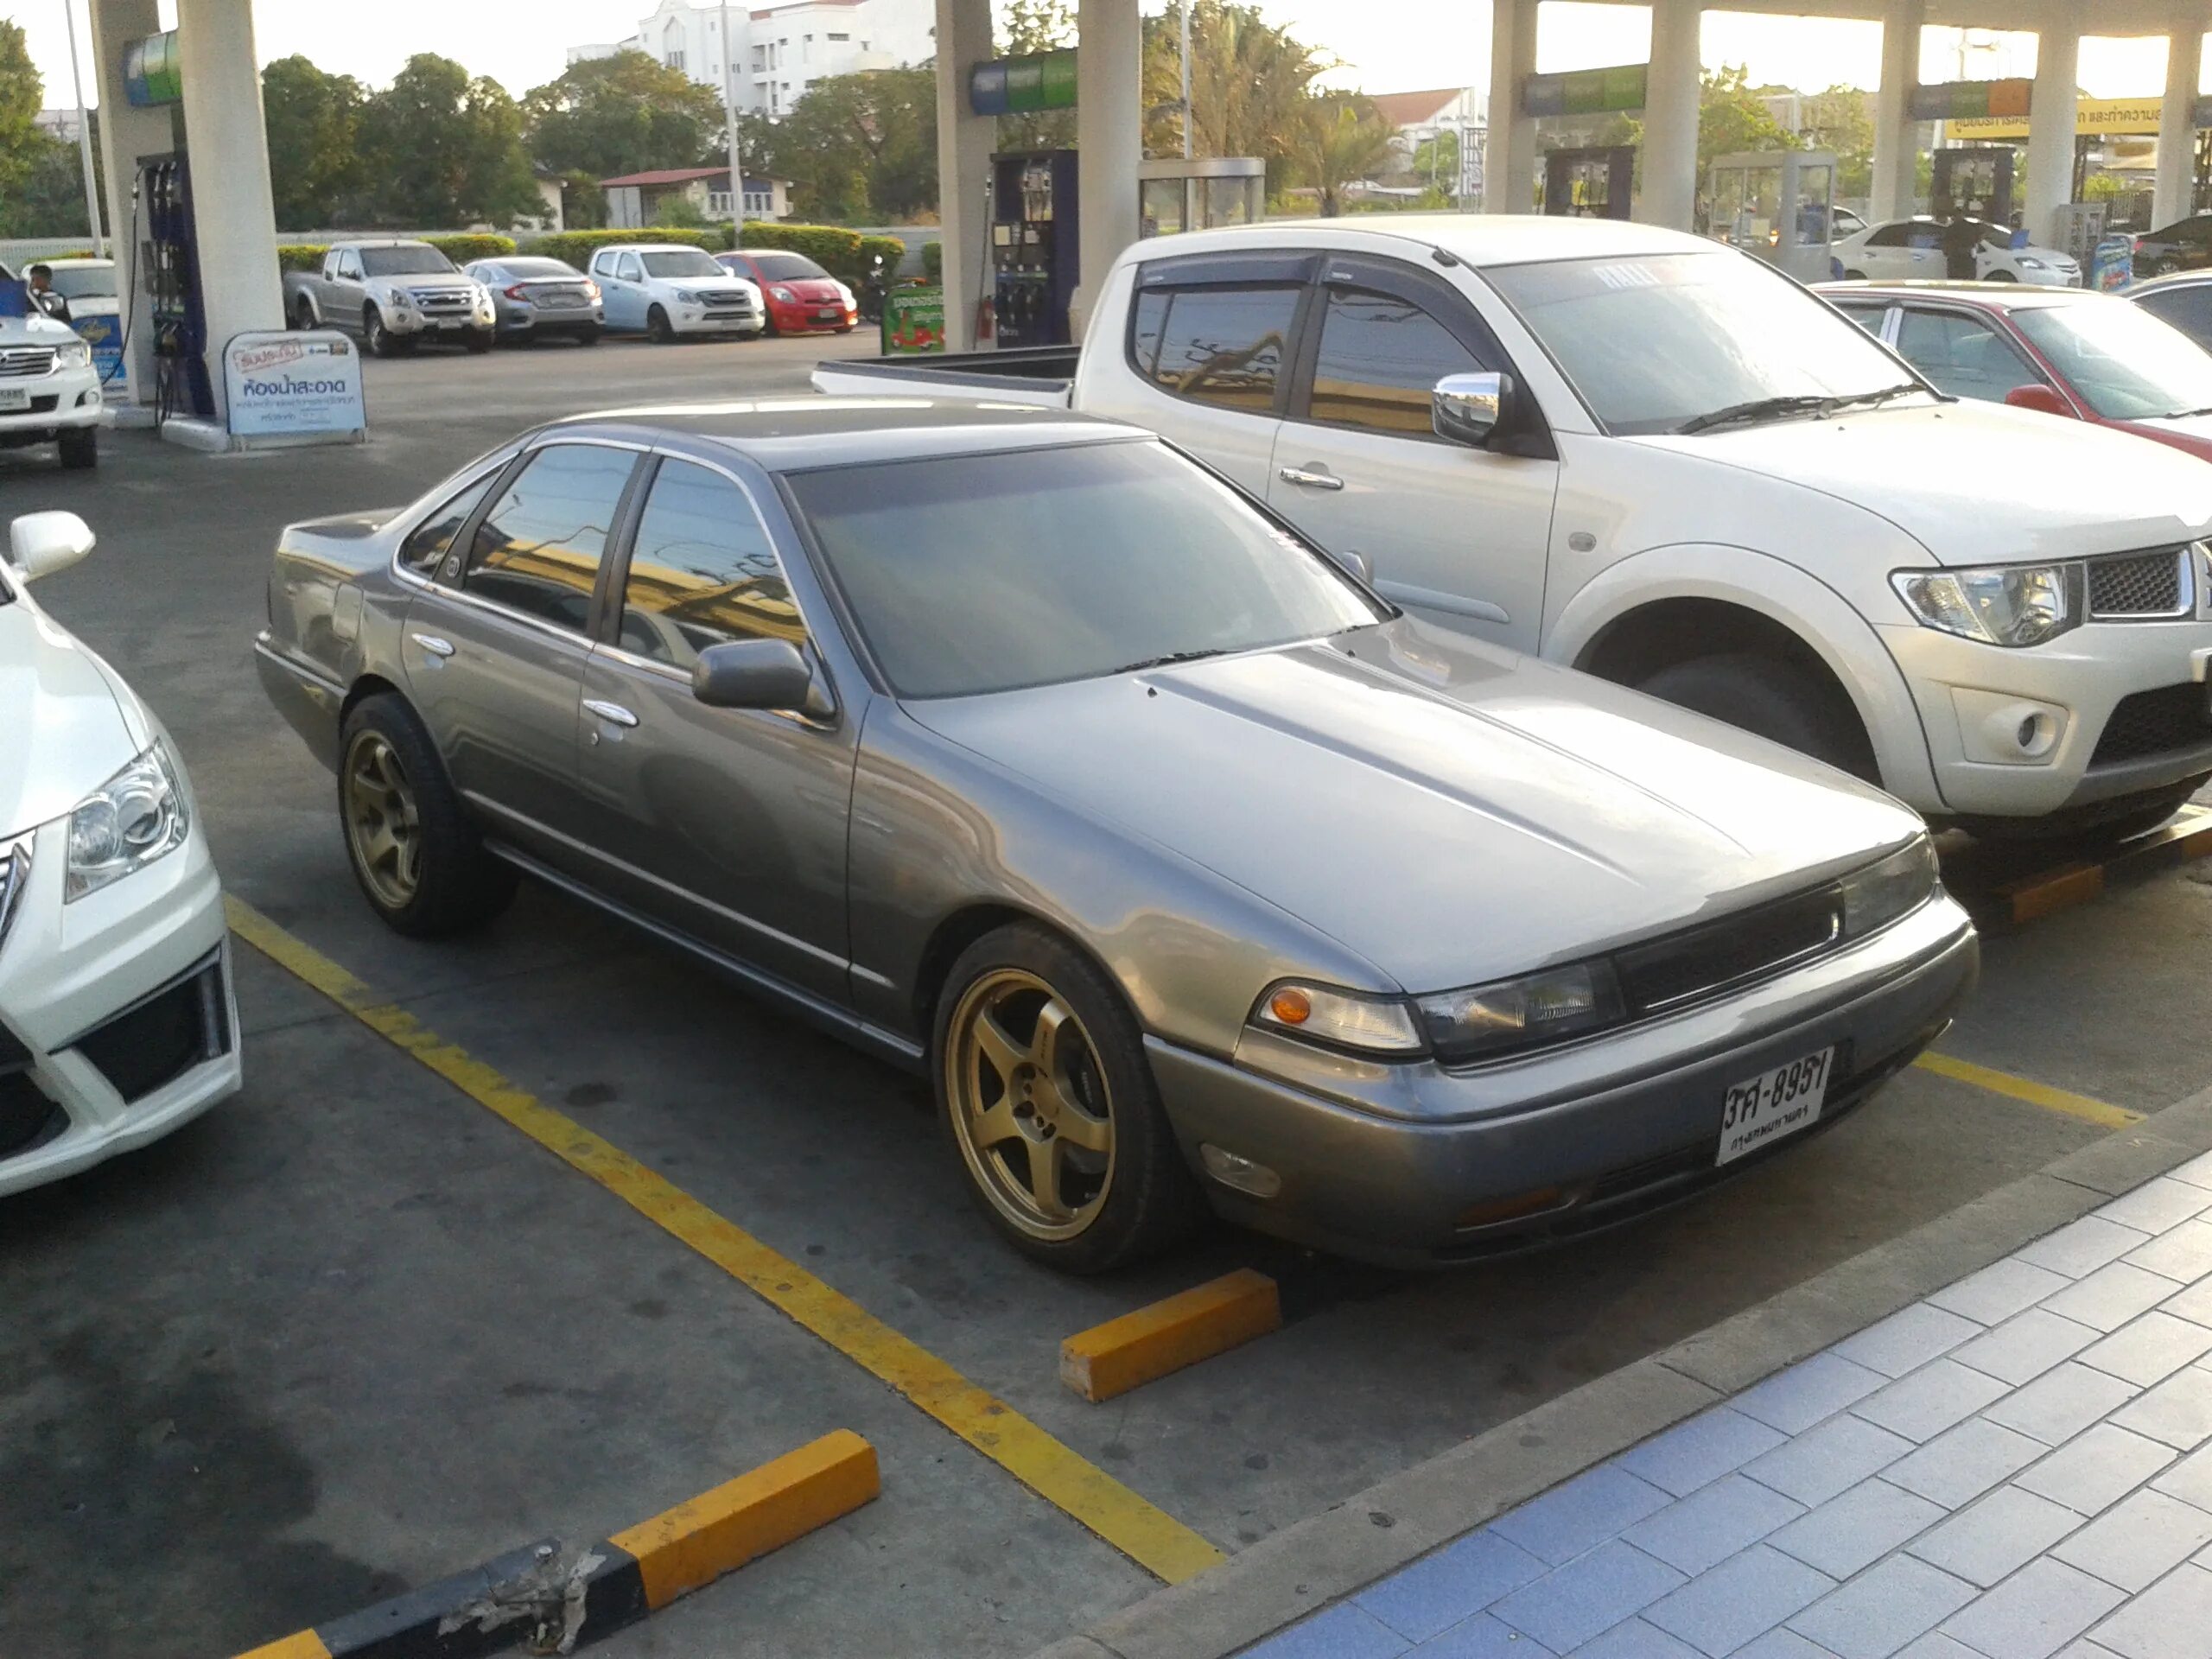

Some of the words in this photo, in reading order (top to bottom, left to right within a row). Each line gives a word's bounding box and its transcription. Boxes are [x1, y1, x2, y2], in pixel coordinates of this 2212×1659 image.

[244, 373, 346, 397] ห้องน้ำสะอาด
[1731, 1104, 1808, 1151] กรุงเทพมหานคร
